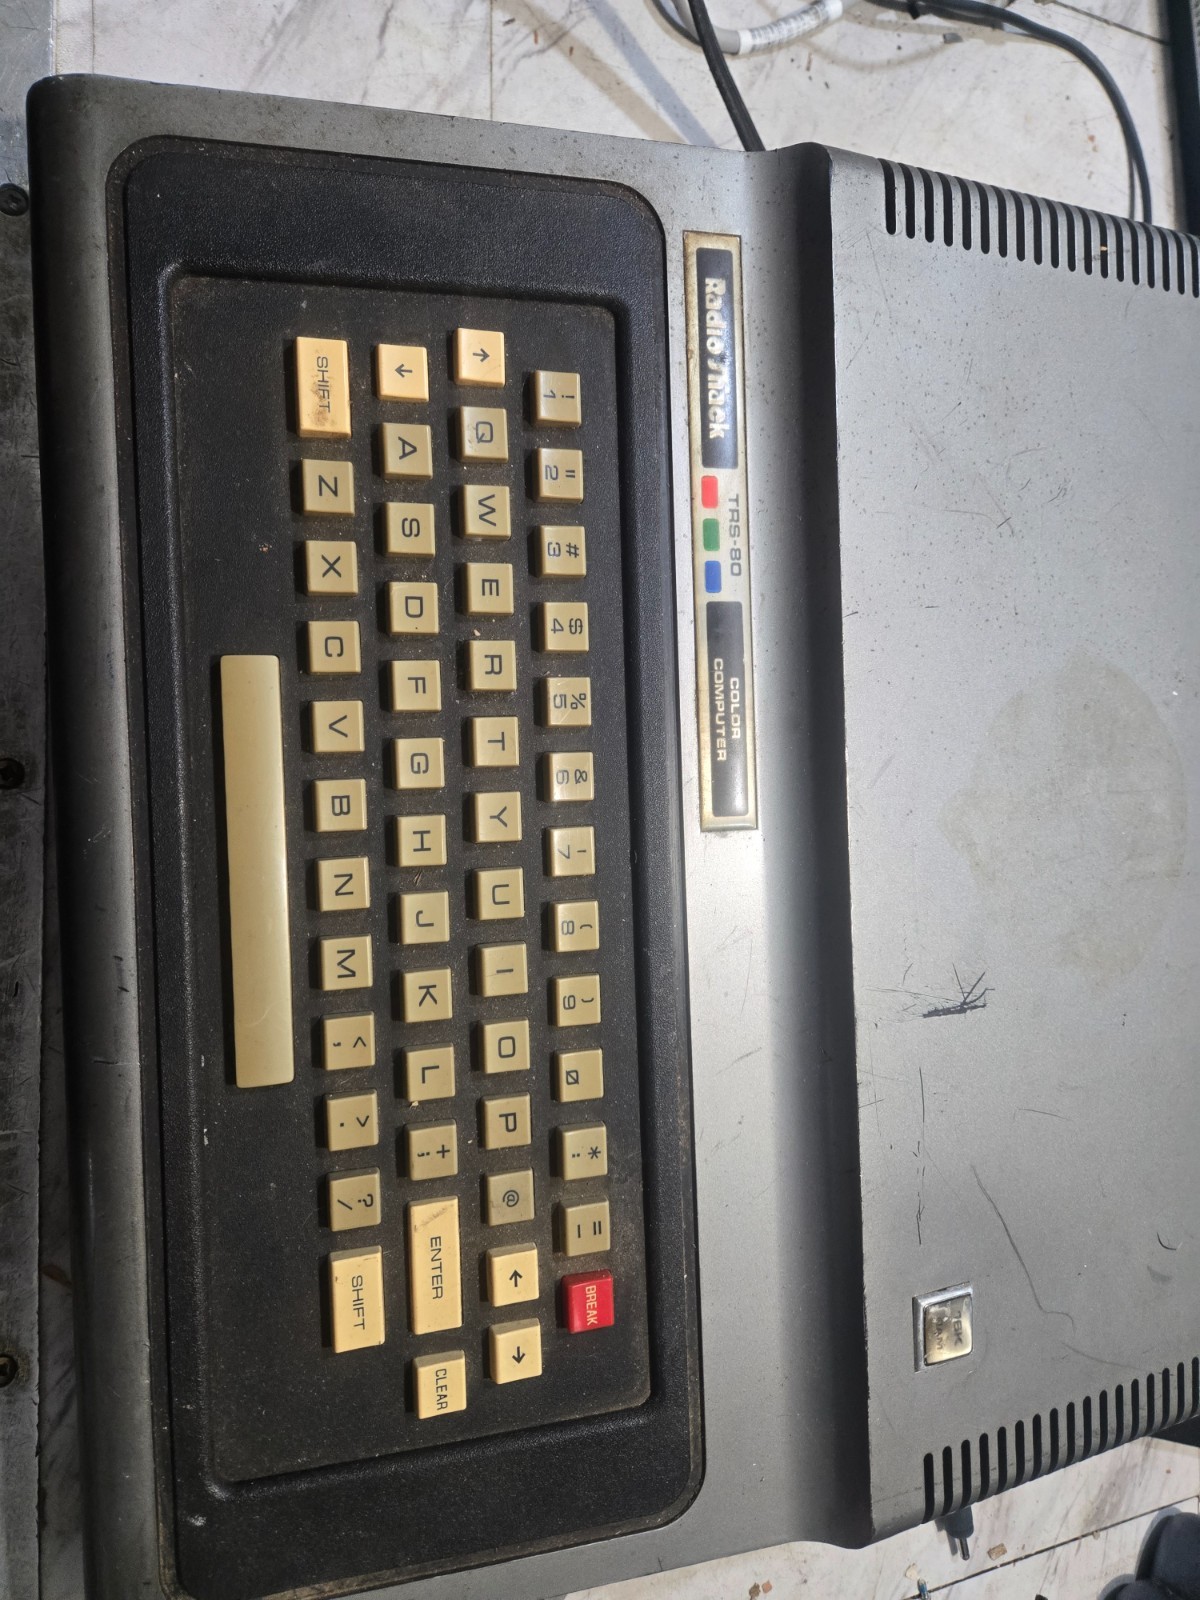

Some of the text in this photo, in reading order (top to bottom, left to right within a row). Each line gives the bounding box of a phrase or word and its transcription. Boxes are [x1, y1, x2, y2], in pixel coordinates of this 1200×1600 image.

[705, 277, 726, 354] Radio
[317, 357, 330, 413] SHIFT
[544, 390, 556, 398] 1
[476, 422, 493, 443] Q
[398, 437, 417, 459] A
[546, 466, 558, 480] 2
[319, 475, 338, 497] Z
[478, 495, 496, 526] W
[402, 518, 420, 537] S
[728, 494, 741, 577] TRS-80
[548, 543, 561, 556] 3
[566, 543, 579, 558] #
[322, 555, 341, 577] X
[482, 579, 499, 596] E
[405, 596, 423, 618] D
[551, 619, 564, 633] 4
[569, 618, 583, 634] $
[325, 637, 343, 657] C
[485, 655, 502, 675] R
[408, 677, 426, 693] F
[554, 695, 566, 708] 5
[571, 693, 586, 709] %
[714, 658, 726, 761] COMPUTER
[730, 678, 741, 739] COLOR
[329, 715, 348, 737] V
[488, 732, 505, 751] T
[411, 753, 429, 774] G
[556, 769, 569, 784] 6
[575, 769, 587, 784] &
[332, 795, 350, 816] B
[490, 806, 507, 827] Y
[413, 831, 431, 852] H
[558, 844, 570, 860] 7
[334, 874, 353, 896] N
[492, 884, 509, 905] U
[416, 911, 434, 927] J
[562, 921, 574, 934] 8
[337, 950, 356, 978] M
[419, 985, 437, 1006] K
[563, 995, 575, 1010] 9
[498, 1036, 515, 1058] O
[422, 1066, 439, 1083] L
[499, 1113, 516, 1132] P
[437, 1145, 450, 1158] +
[358, 1194, 373, 1207] ?
[503, 1190, 519, 1207] @
[431, 1236, 443, 1299] ENTER
[352, 1276, 365, 1329] SHIFT
[586, 1285, 597, 1325] BREAK
[436, 1369, 447, 1410] CLEAR
